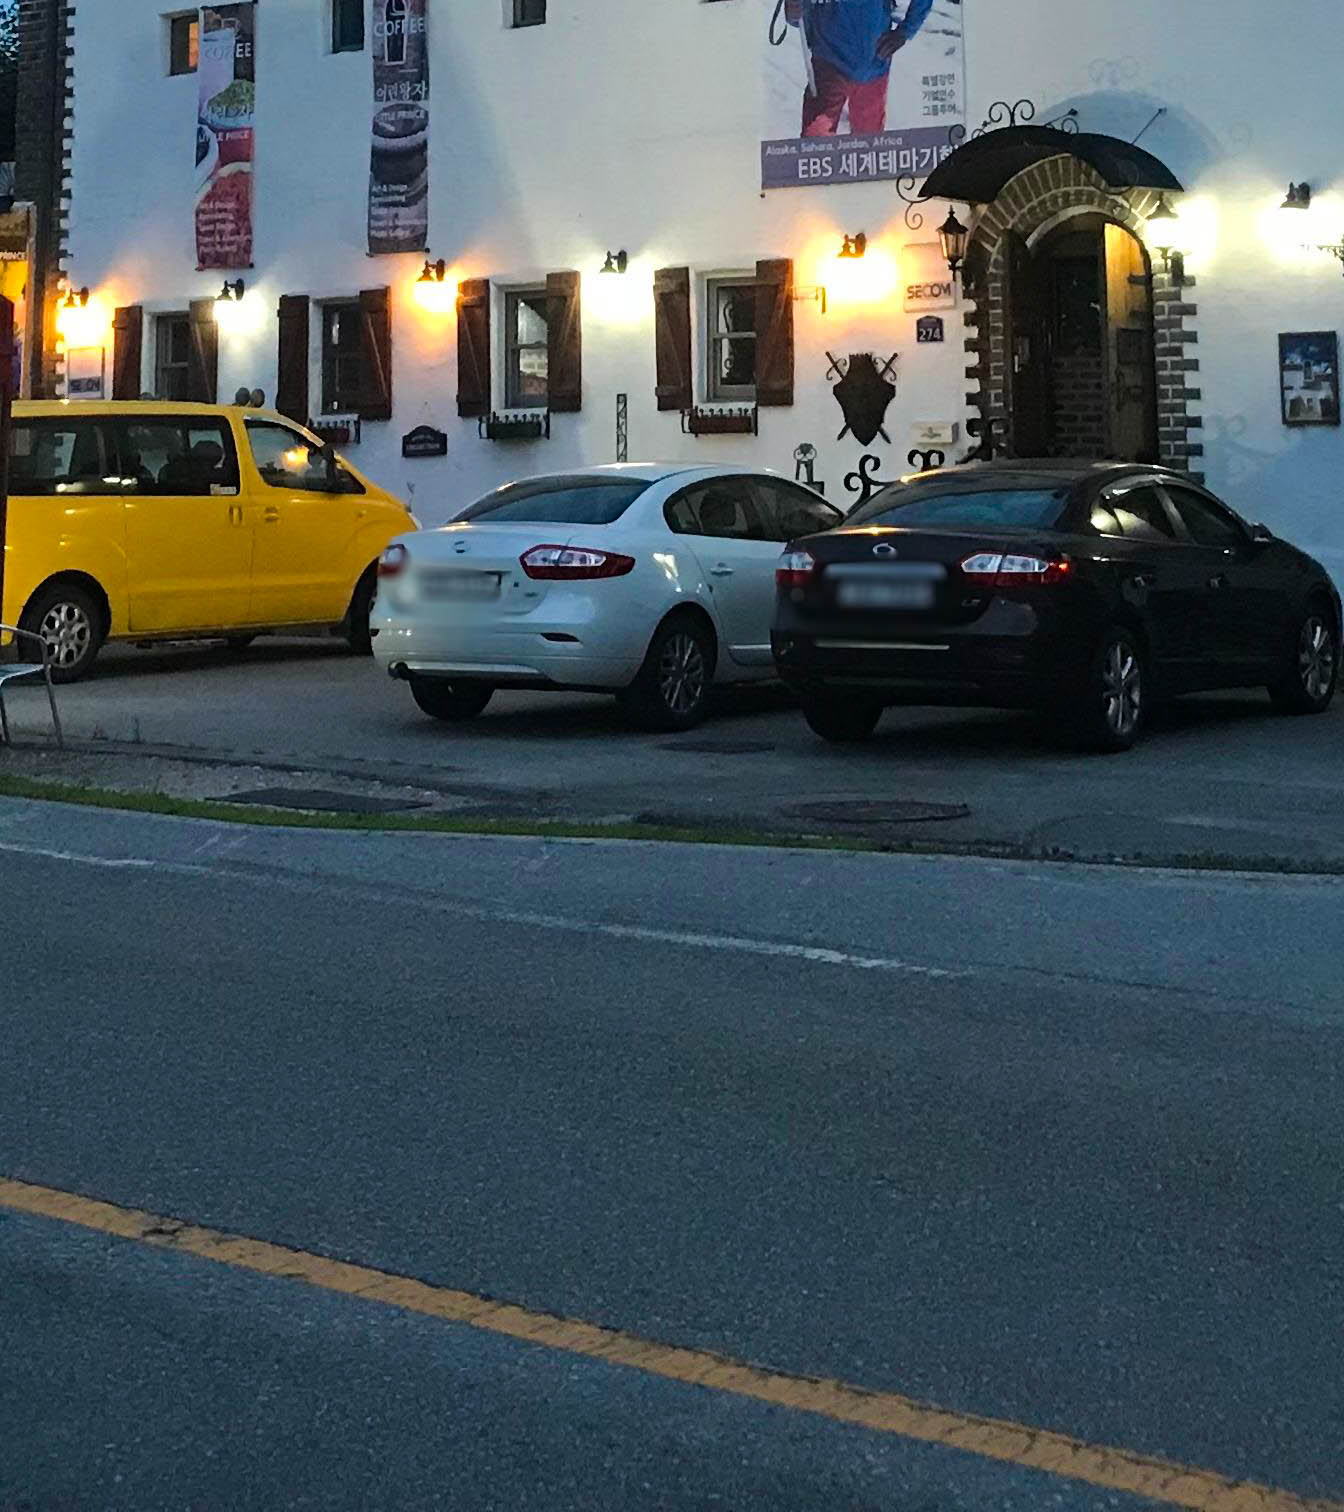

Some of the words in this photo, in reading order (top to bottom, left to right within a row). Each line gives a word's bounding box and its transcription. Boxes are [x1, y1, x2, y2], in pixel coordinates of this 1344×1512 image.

[374, 17, 425, 37] COFFEE
[376, 80, 427, 103] 어린왕자
[872, 136, 903, 147] Africa
[798, 156, 833, 180] EBS
[907, 283, 951, 299] SECOM
[919, 328, 942, 341] 274
